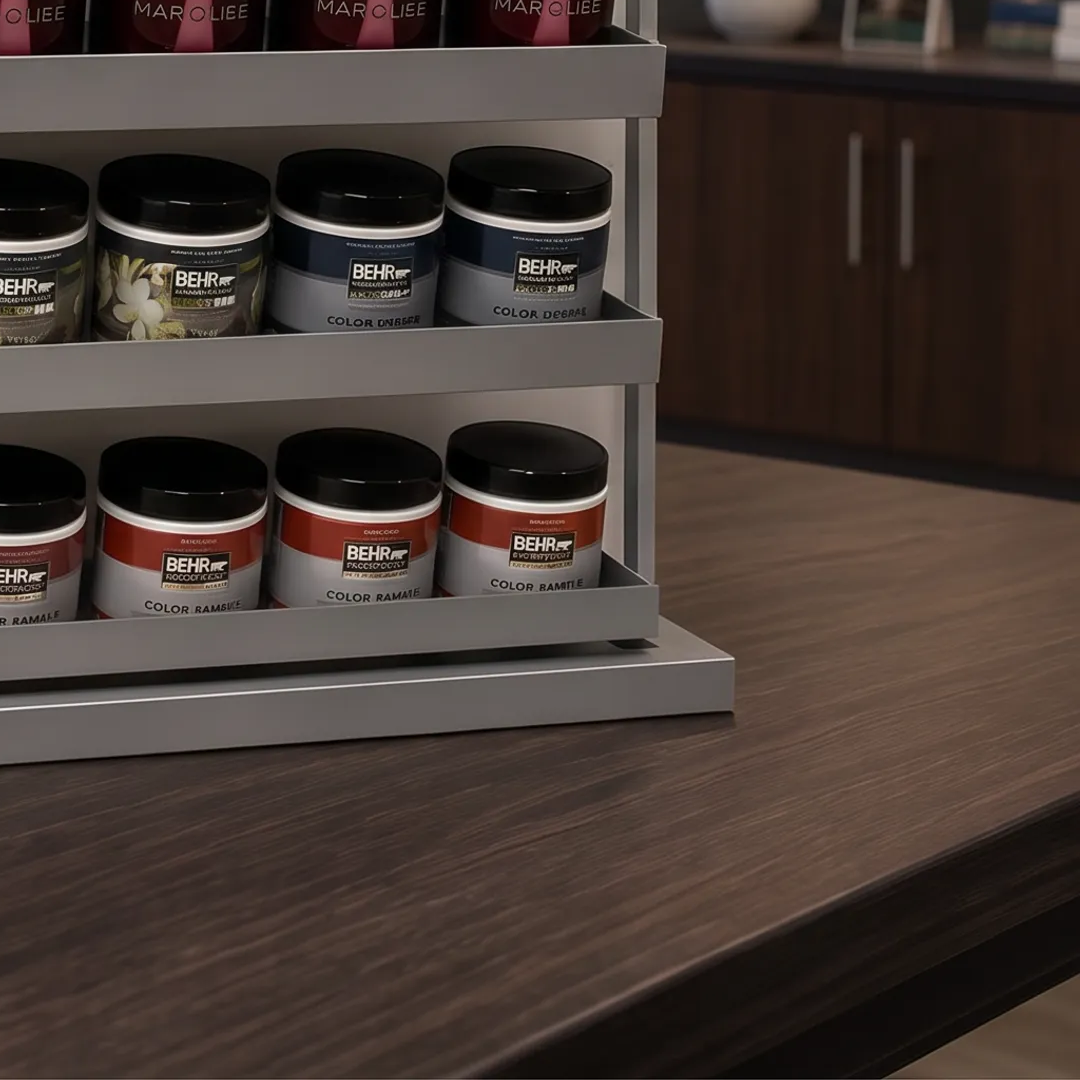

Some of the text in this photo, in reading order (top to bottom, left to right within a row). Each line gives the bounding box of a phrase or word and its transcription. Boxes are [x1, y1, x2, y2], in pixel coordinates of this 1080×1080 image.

[353, 263, 395, 280] BEHR
[518, 257, 562, 275] BEHR
[175, 271, 220, 288] BEHR
[493, 306, 538, 319] COLOR
[327, 315, 373, 328] COLOR
[513, 535, 556, 552] BEHR
[347, 545, 391, 561] BEHR
[166, 557, 210, 573] BEHR
[490, 578, 534, 592] COLOR
[326, 590, 371, 603] COLOR
[144, 600, 189, 614] COLOR
